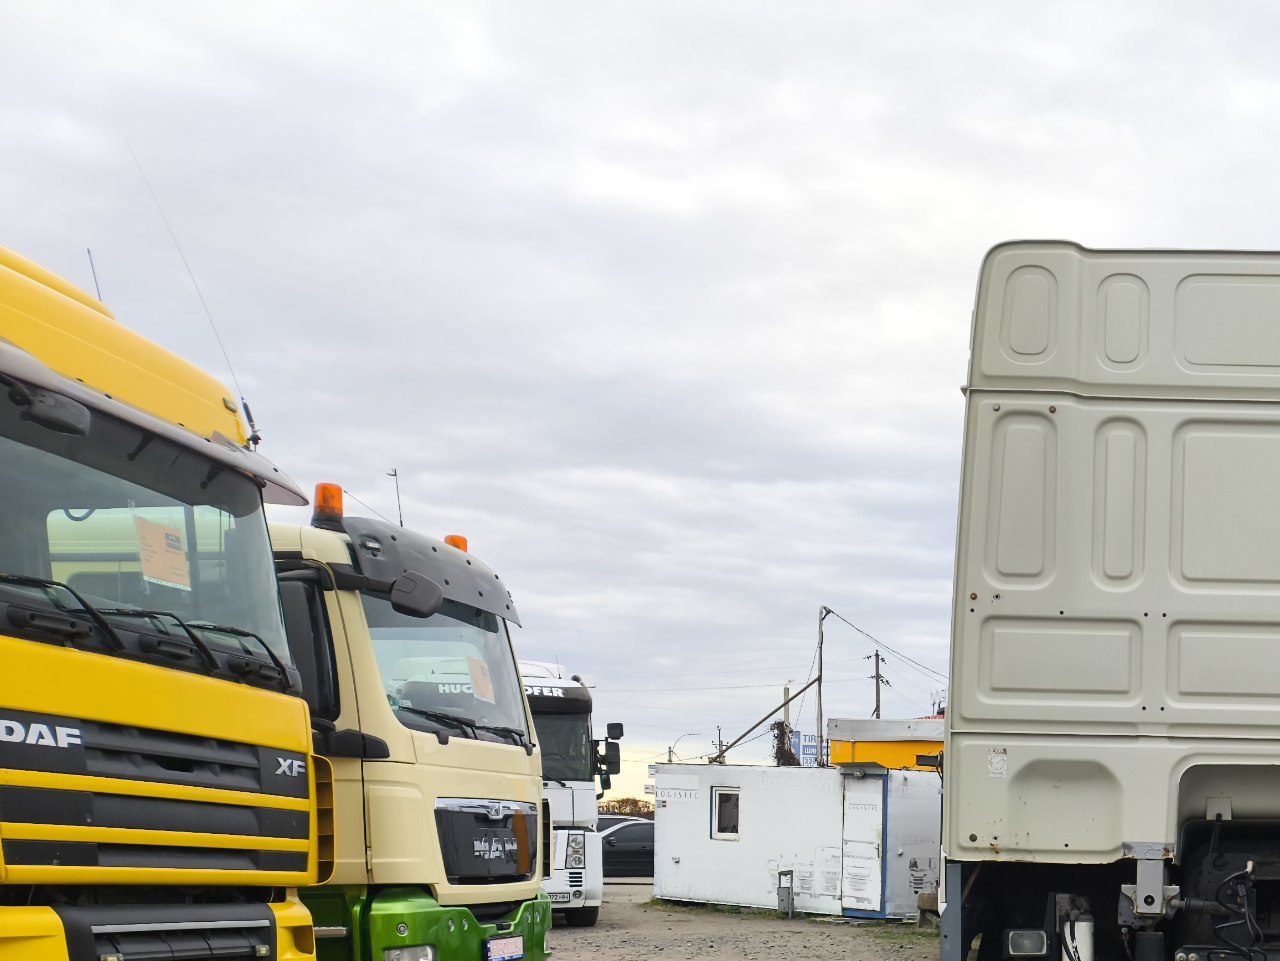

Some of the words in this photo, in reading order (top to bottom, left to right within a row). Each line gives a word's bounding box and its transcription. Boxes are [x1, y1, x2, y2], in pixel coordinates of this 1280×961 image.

[0, 720, 81, 748] DAF
[275, 757, 306, 777] XF
[802, 734, 816, 743] TIR
[473, 838, 519, 861] MAN
